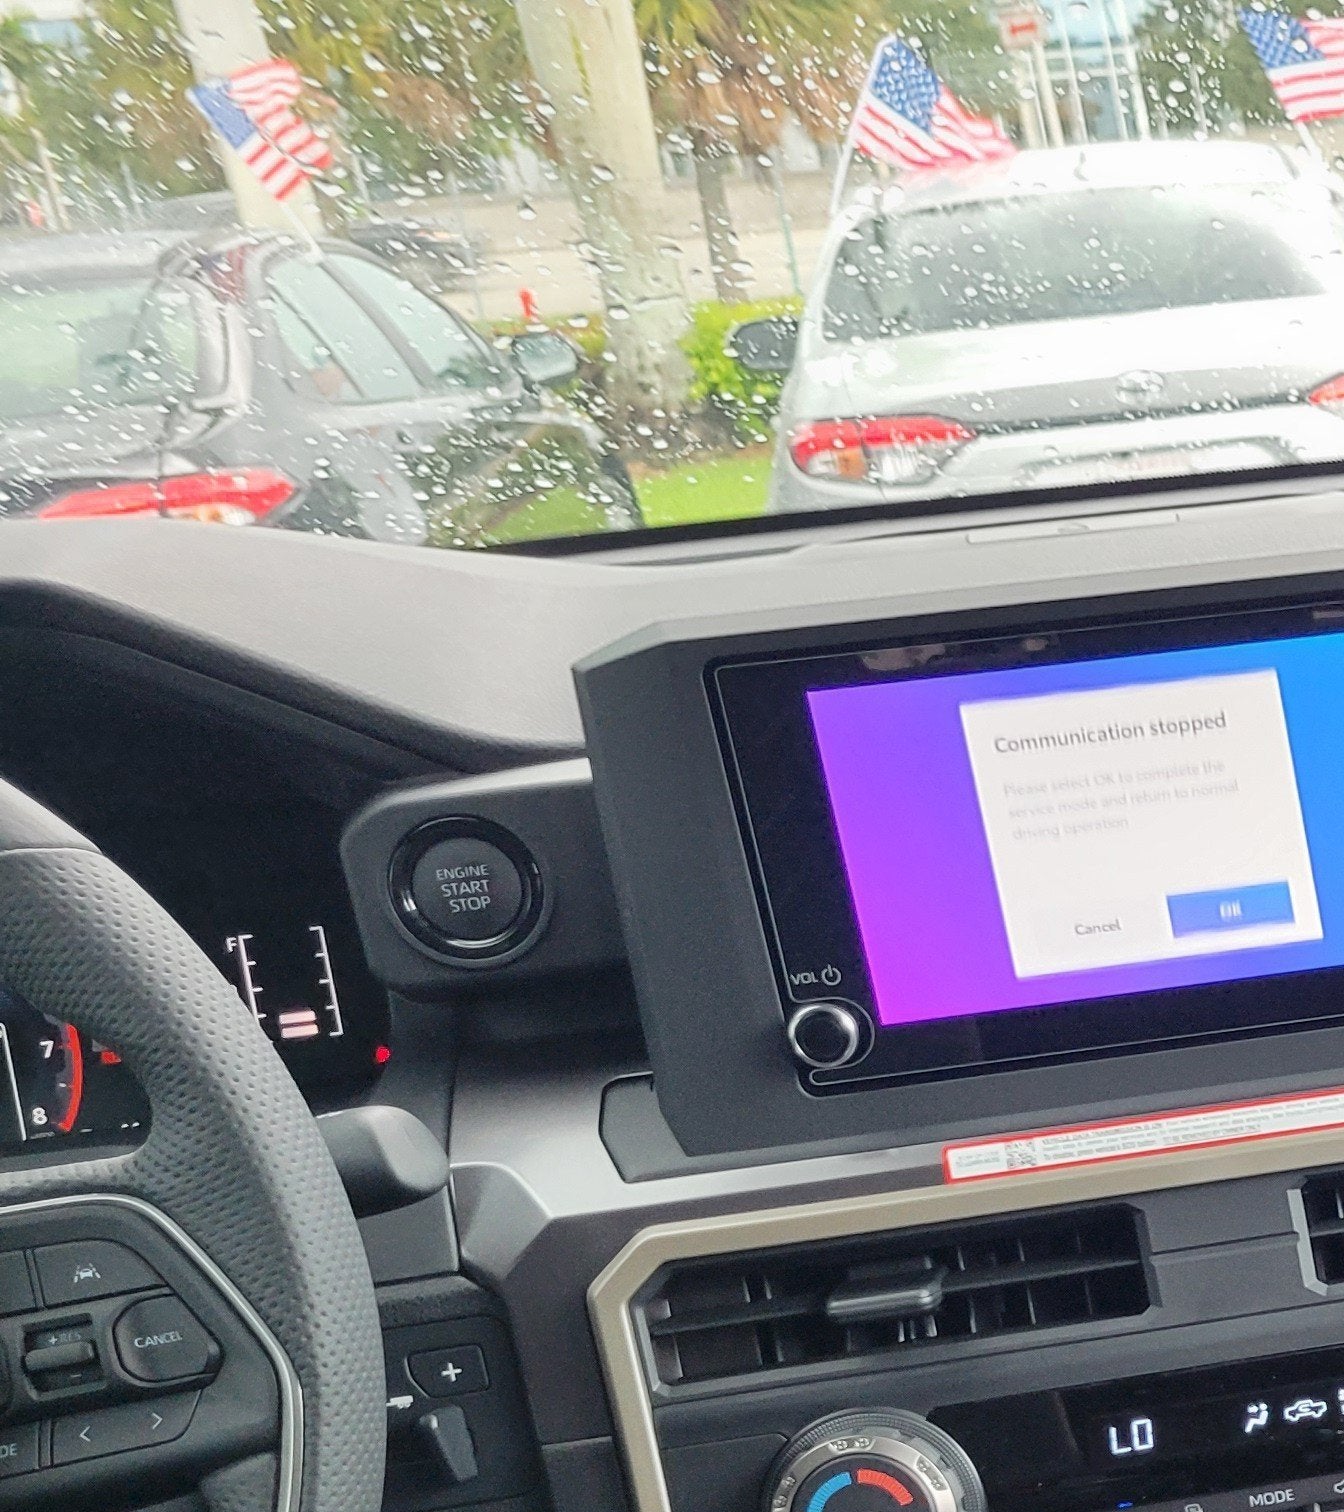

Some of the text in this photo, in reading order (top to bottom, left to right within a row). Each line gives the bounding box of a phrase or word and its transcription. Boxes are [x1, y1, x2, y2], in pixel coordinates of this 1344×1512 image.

[994, 709, 1227, 754] Communication stopped
[436, 864, 490, 880] ENGINE
[441, 880, 489, 897] START
[449, 896, 491, 913] STOP
[1074, 918, 1122, 936] Cancel
[226, 936, 238, 953] F
[790, 971, 818, 985] VOL
[39, 1040, 55, 1059] 7
[32, 1107, 48, 1125] 8
[134, 1331, 183, 1348] CANCEL
[1108, 1418, 1154, 1455] LO
[1249, 1488, 1296, 1507] MODE
